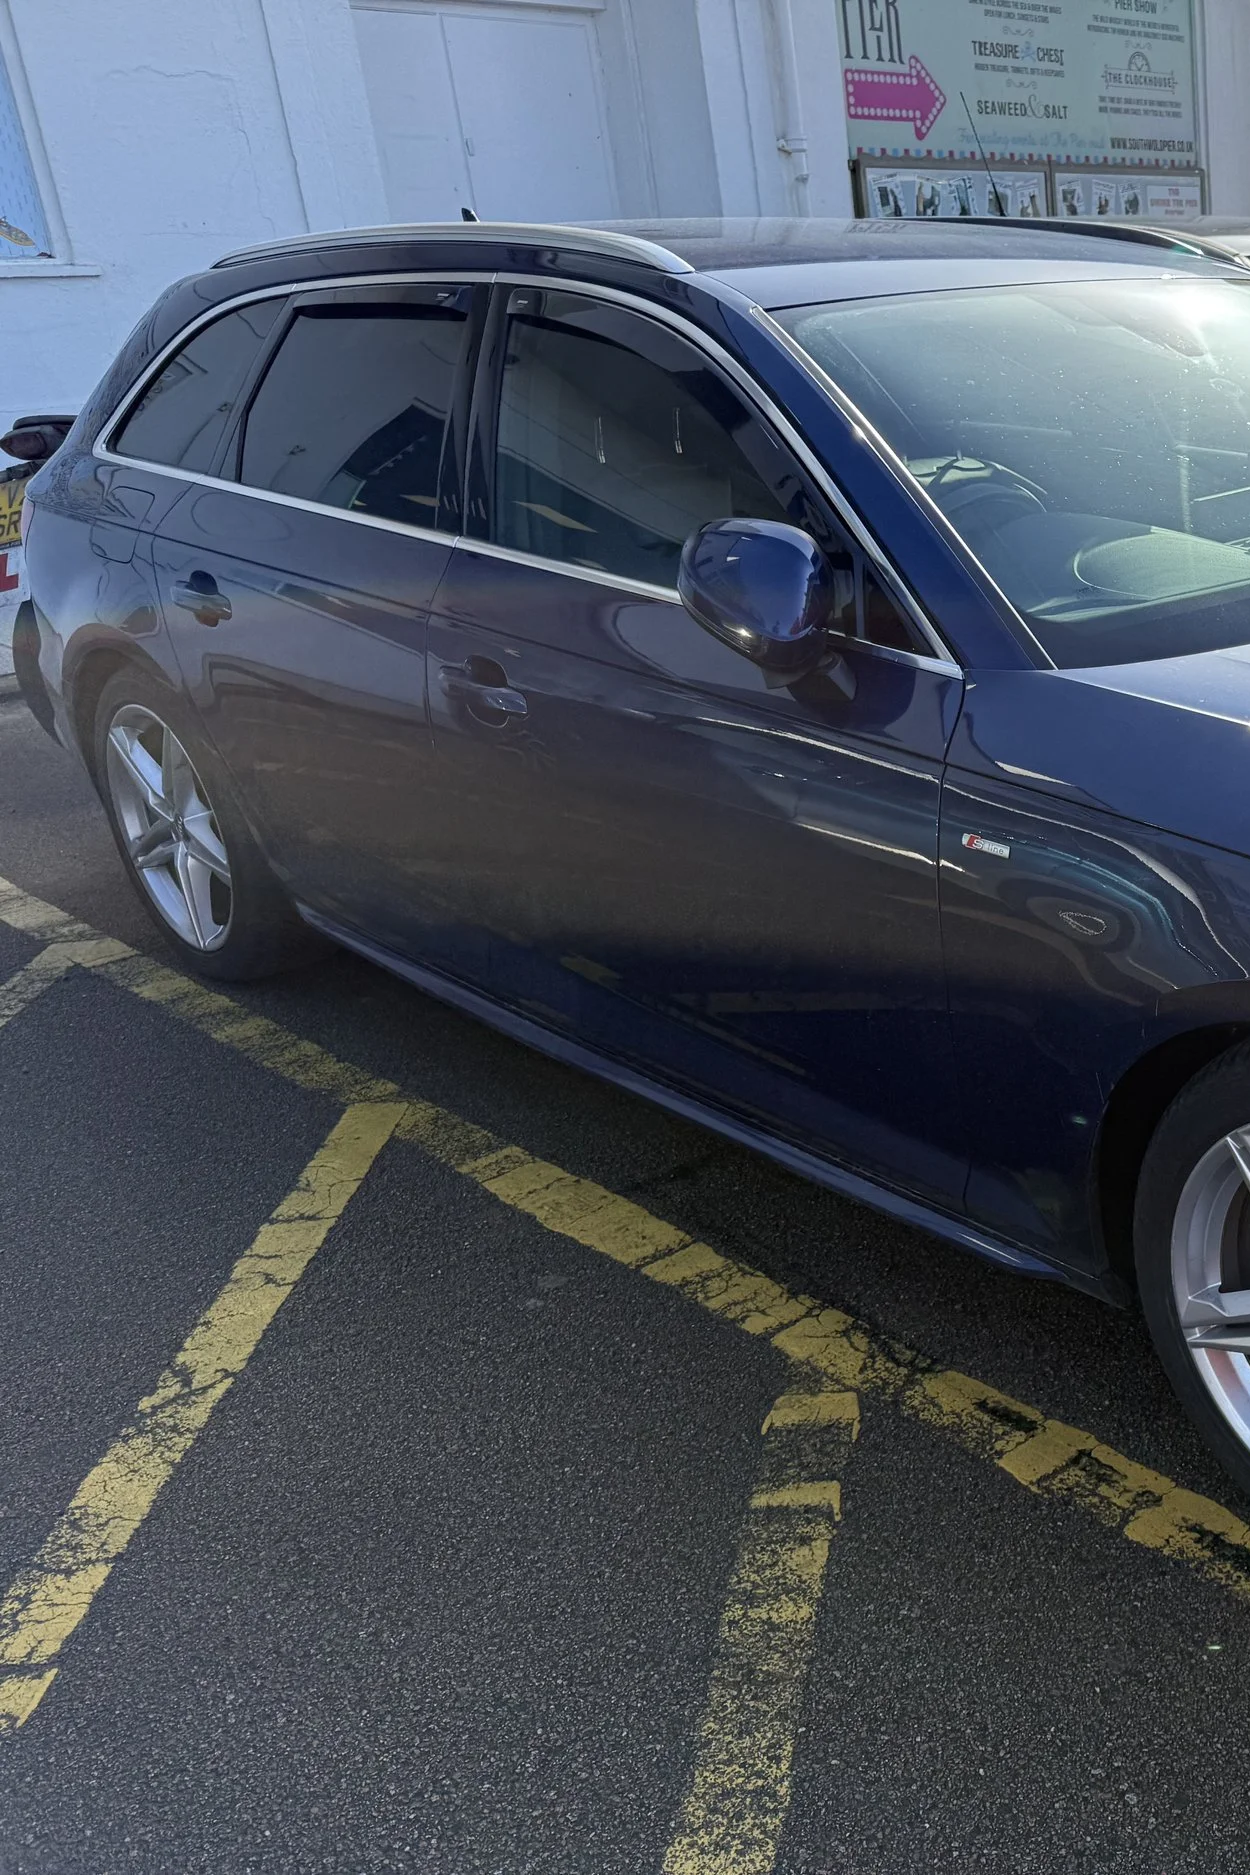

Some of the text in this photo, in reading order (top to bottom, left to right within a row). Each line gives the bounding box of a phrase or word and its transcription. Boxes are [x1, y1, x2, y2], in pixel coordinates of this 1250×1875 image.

[972, 40, 1064, 66] TREASURE CHEST
[1108, 72, 1173, 88] THE CLOCKHOUSE
[977, 99, 1027, 116] SEAWEED
[1044, 104, 1068, 119] SALT
